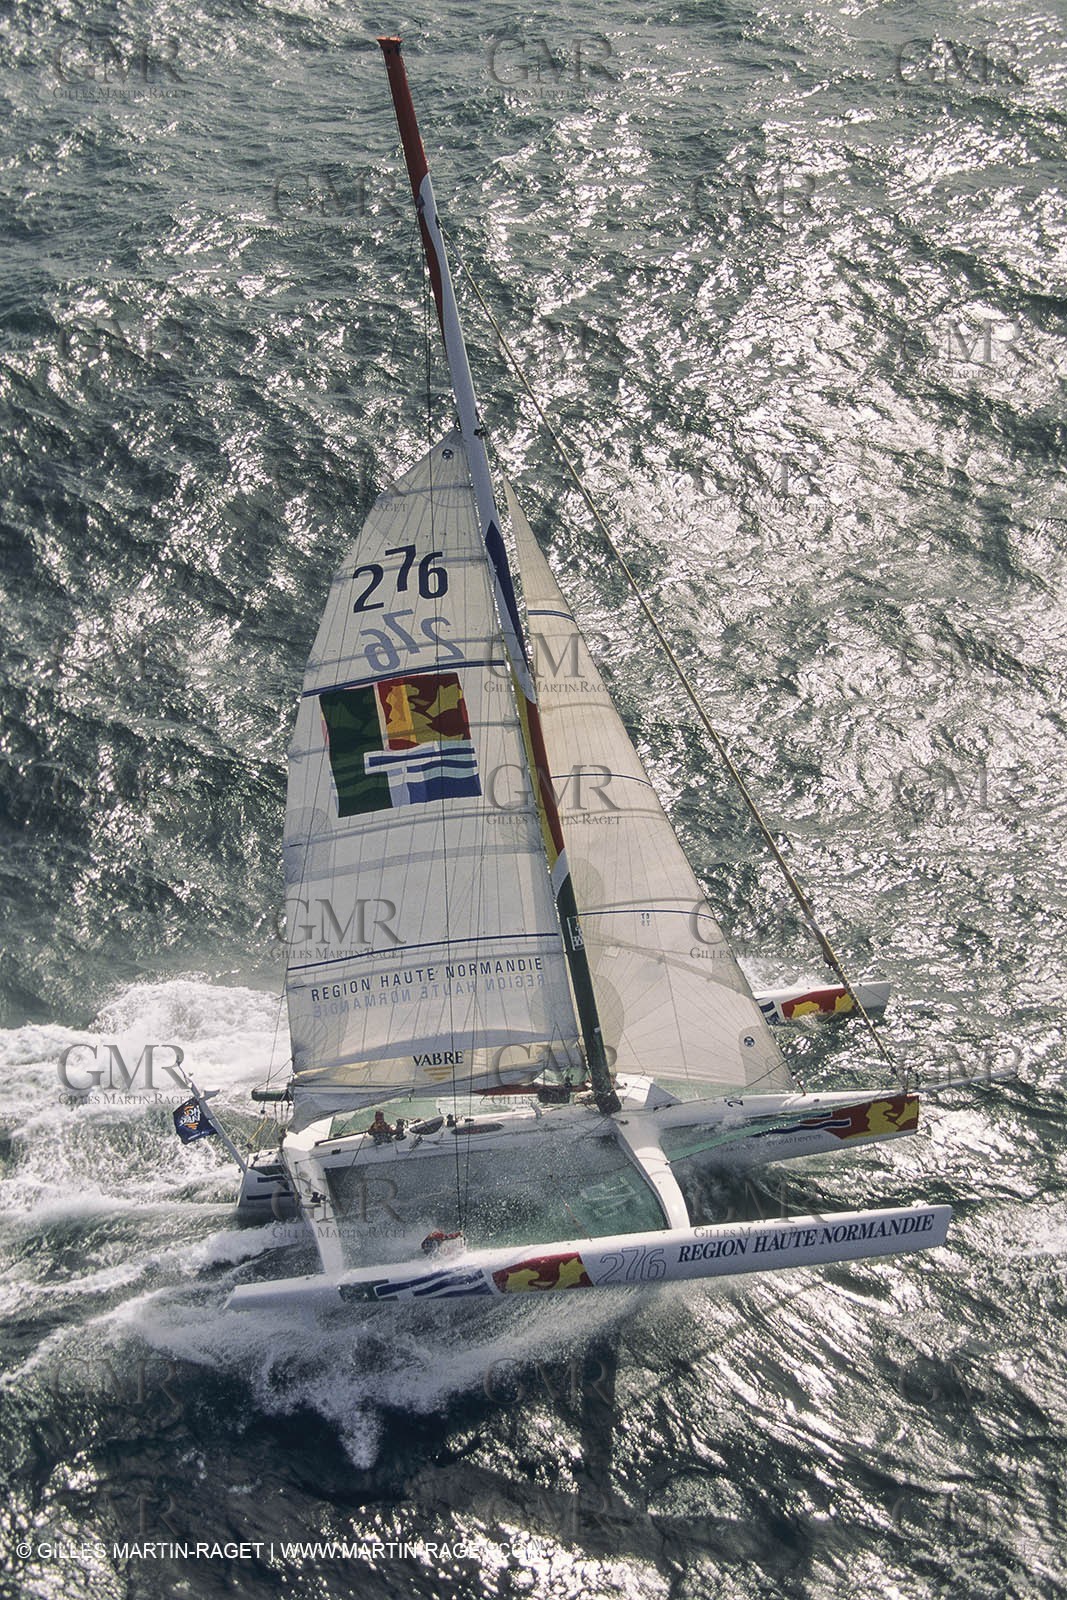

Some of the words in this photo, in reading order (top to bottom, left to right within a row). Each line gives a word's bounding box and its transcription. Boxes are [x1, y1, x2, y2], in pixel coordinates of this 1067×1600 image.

[352, 544, 448, 613] 276
[311, 978, 371, 1002] REGION
[380, 967, 435, 989] HAUTE
[445, 958, 543, 978] NORMANDIE
[413, 1050, 464, 1066] VABRE
[597, 1245, 667, 1285] 276
[677, 1237, 748, 1263] REGION
[752, 1228, 817, 1253] HAUTE
[820, 1214, 935, 1244] NORMANDIE
